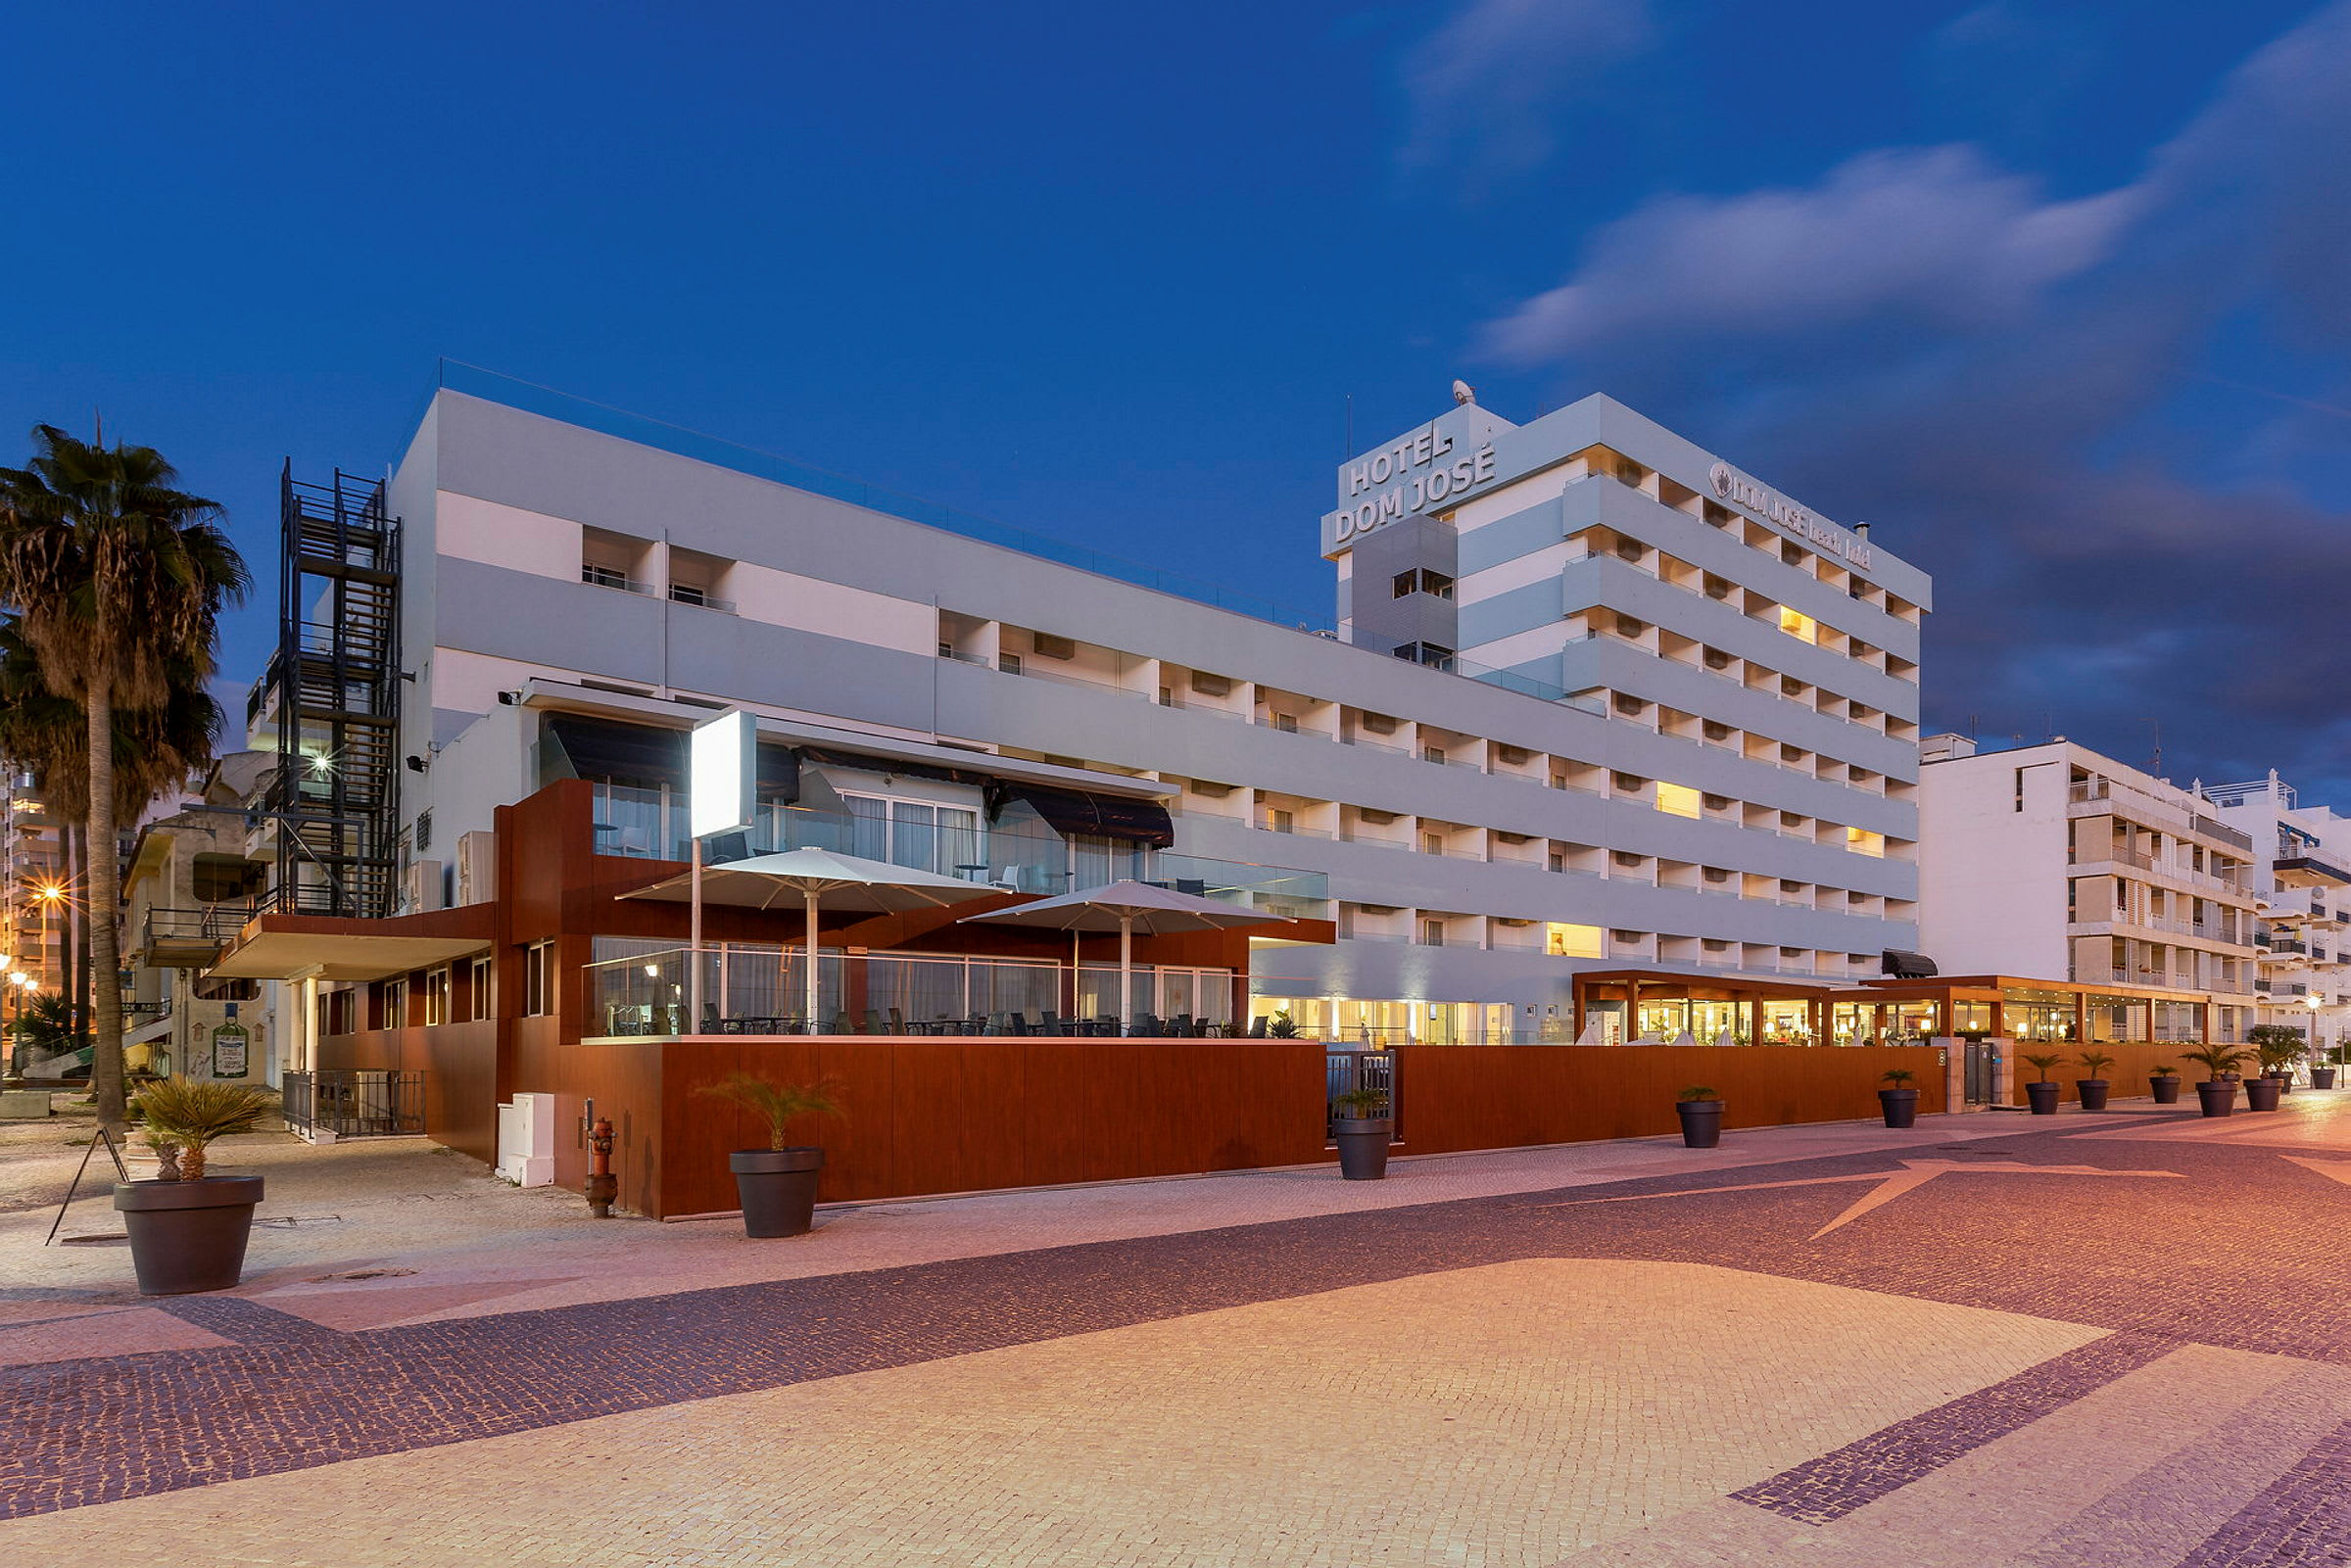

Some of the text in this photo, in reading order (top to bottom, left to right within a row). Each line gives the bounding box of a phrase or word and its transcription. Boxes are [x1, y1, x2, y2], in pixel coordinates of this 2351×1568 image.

[1335, 441, 1496, 543] DOM JOSÉ
[1350, 425, 1453, 497] HOTEL
[1733, 477, 1769, 516] DOM
[1768, 499, 1806, 537] JOSÉ
